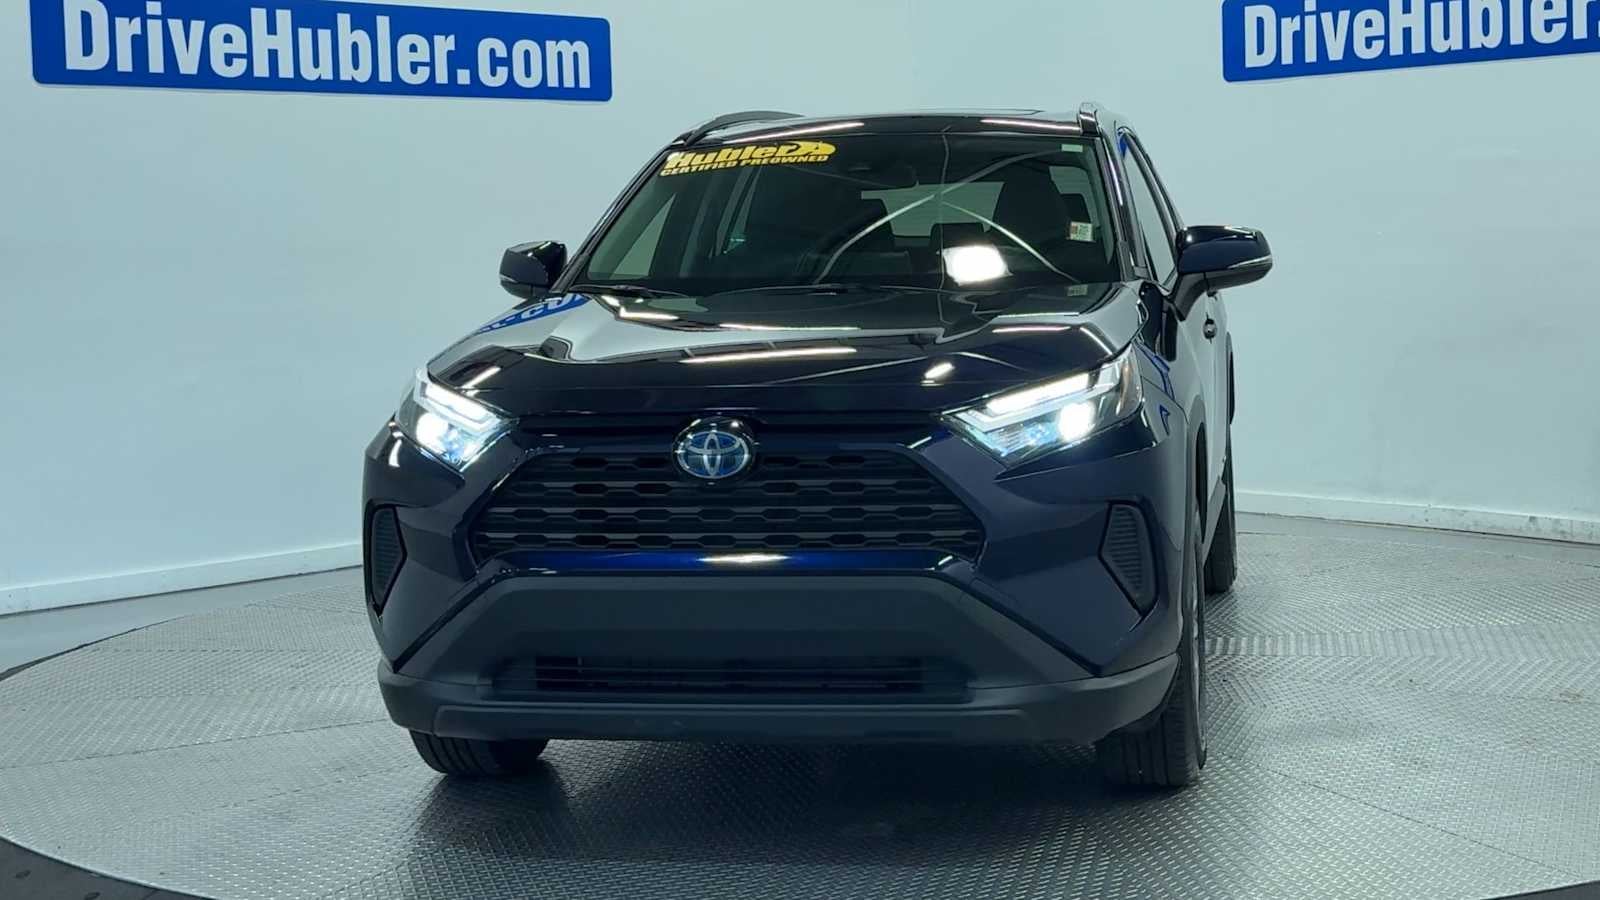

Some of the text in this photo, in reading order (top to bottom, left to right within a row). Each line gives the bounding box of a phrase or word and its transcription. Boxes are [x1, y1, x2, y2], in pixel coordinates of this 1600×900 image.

[64, 0, 592, 89] DriveHubler.com
[1244, 0, 1600, 68] DriveHubler
[660, 155, 829, 177] CERTIFIED PREOWNED
[664, 143, 803, 169] Hubler
